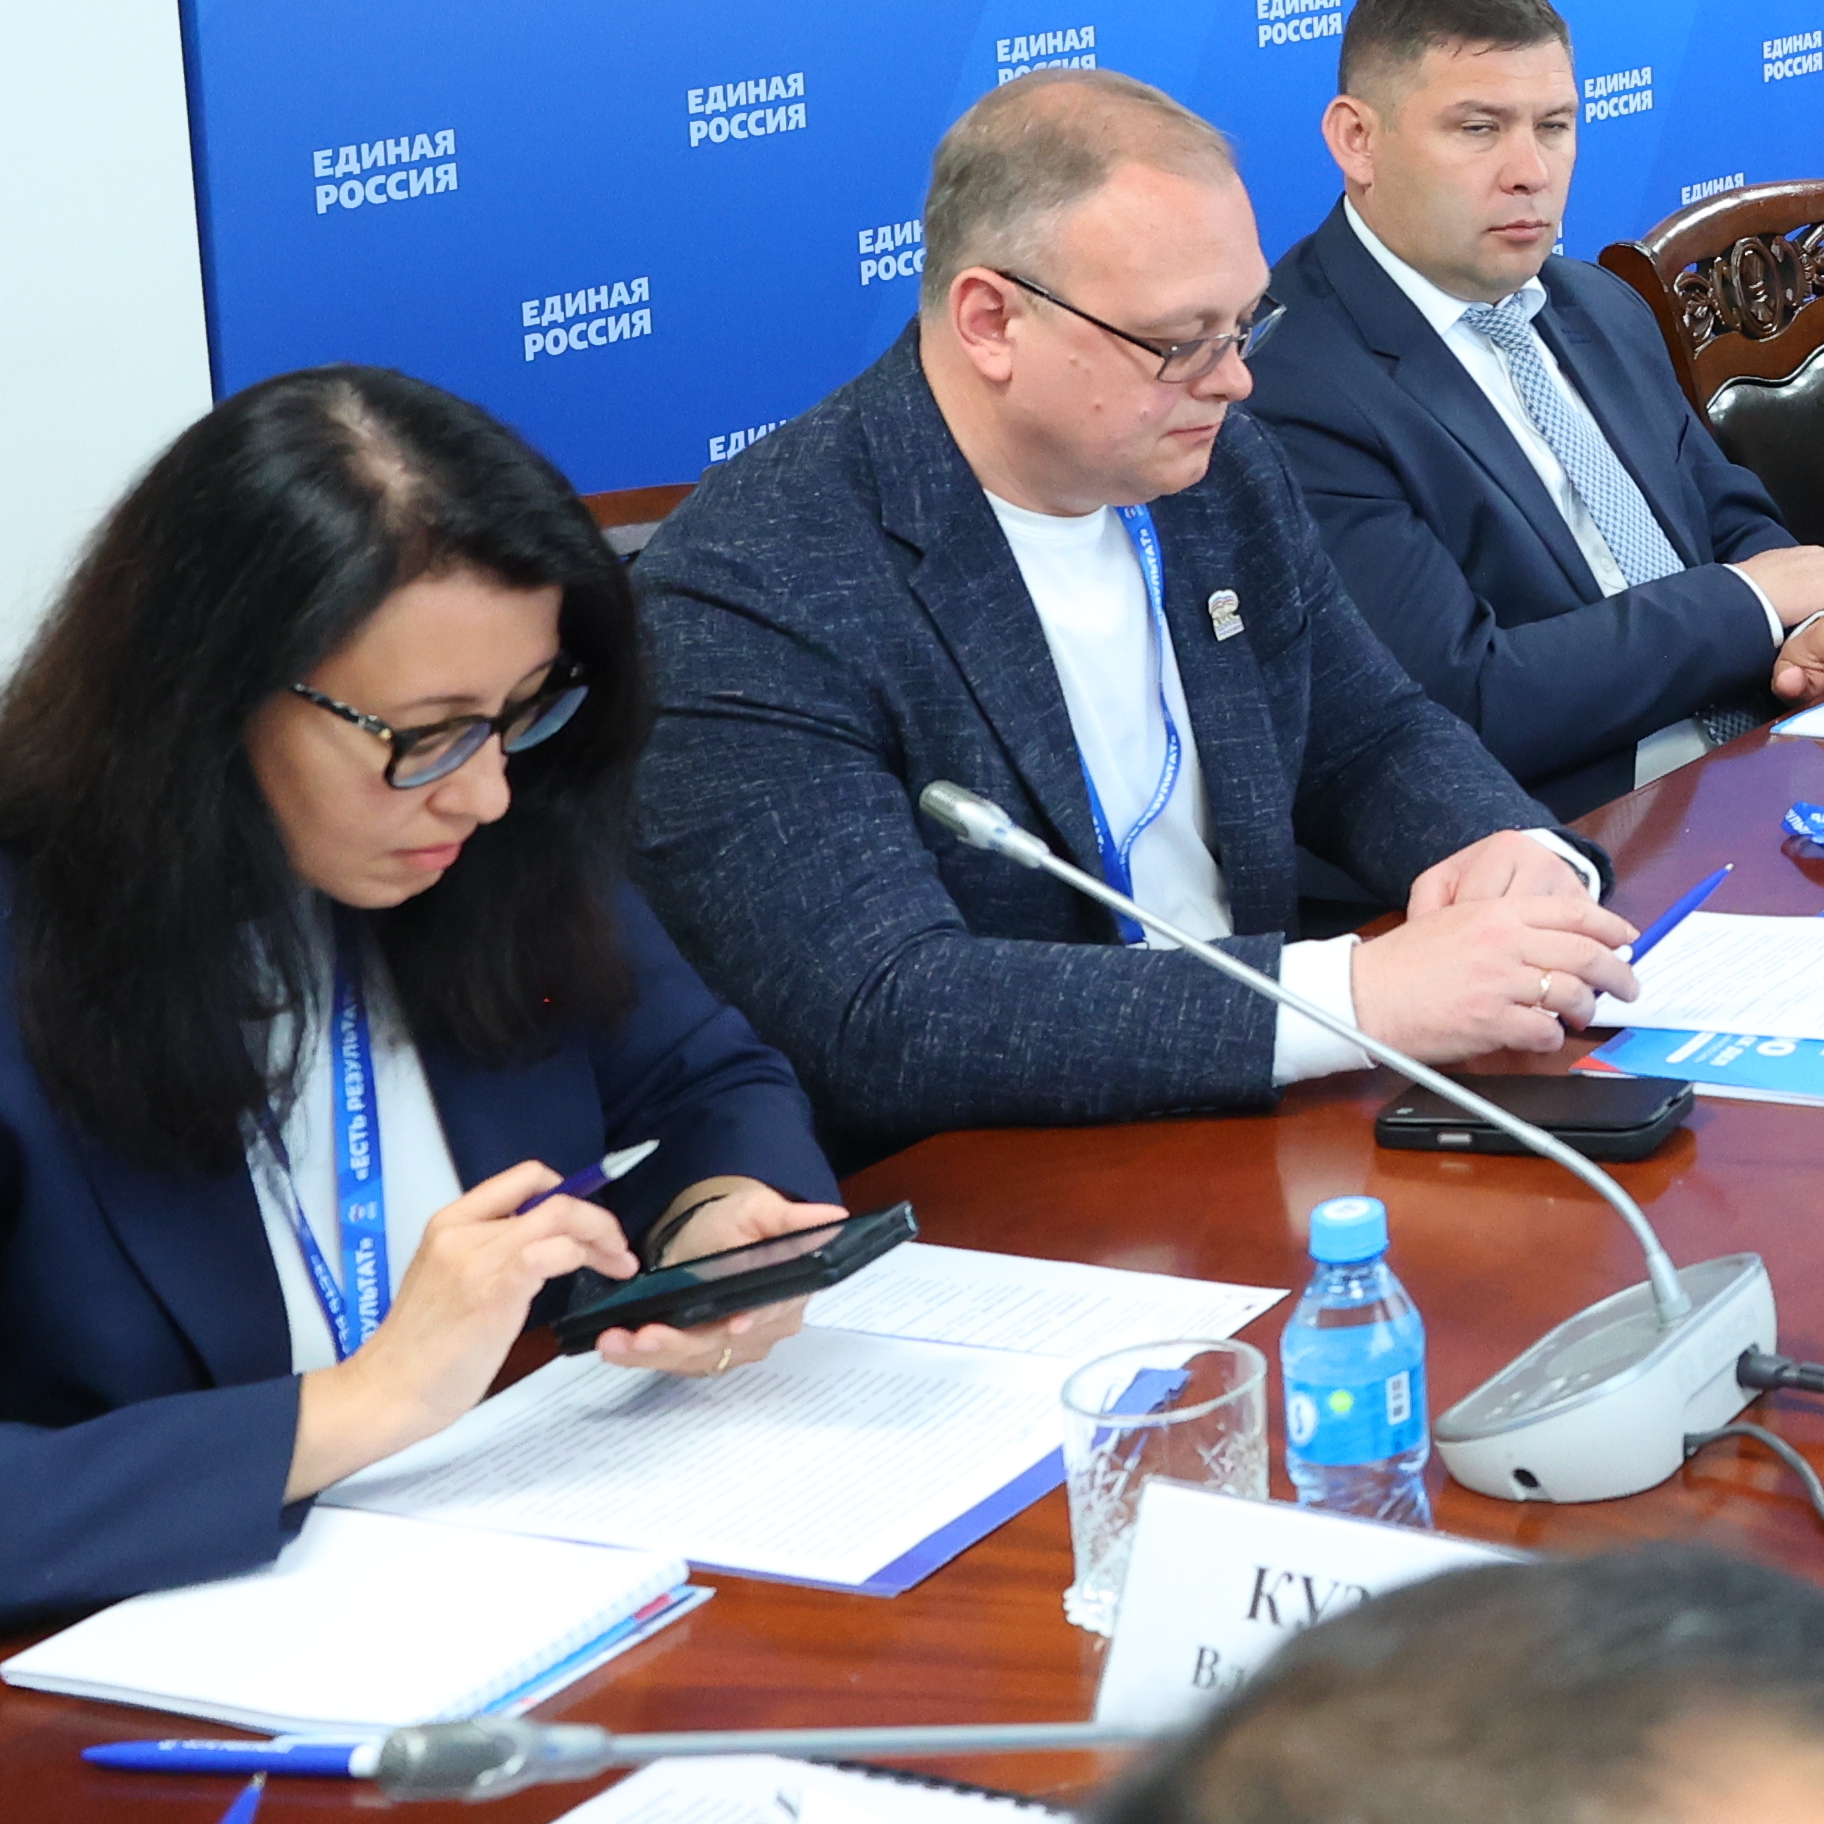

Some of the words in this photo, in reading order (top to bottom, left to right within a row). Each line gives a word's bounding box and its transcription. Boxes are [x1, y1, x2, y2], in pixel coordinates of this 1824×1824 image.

[996, 26, 1095, 62] ЕДИНАЯ
[1259, 12, 1345, 47] РОССИЯ
[1763, 30, 1822, 60] ЕДИНАЯ
[1584, 67, 1652, 98] ЕДИНАЯ
[1763, 52, 1823, 82] РОССИЯ
[688, 72, 804, 114] ЕДИНАЯ
[1585, 90, 1653, 123] РОССИЯ
[689, 103, 806, 147] РОССИЯ
[313, 129, 455, 178] ЕДИНАЯ
[316, 162, 458, 214] РОССИЯ
[858, 219, 924, 254] ЕДИН
[860, 247, 926, 286] РОСС
[522, 277, 649, 327] ЕДИНАЯ
[524, 308, 652, 361] РОССИЯ
